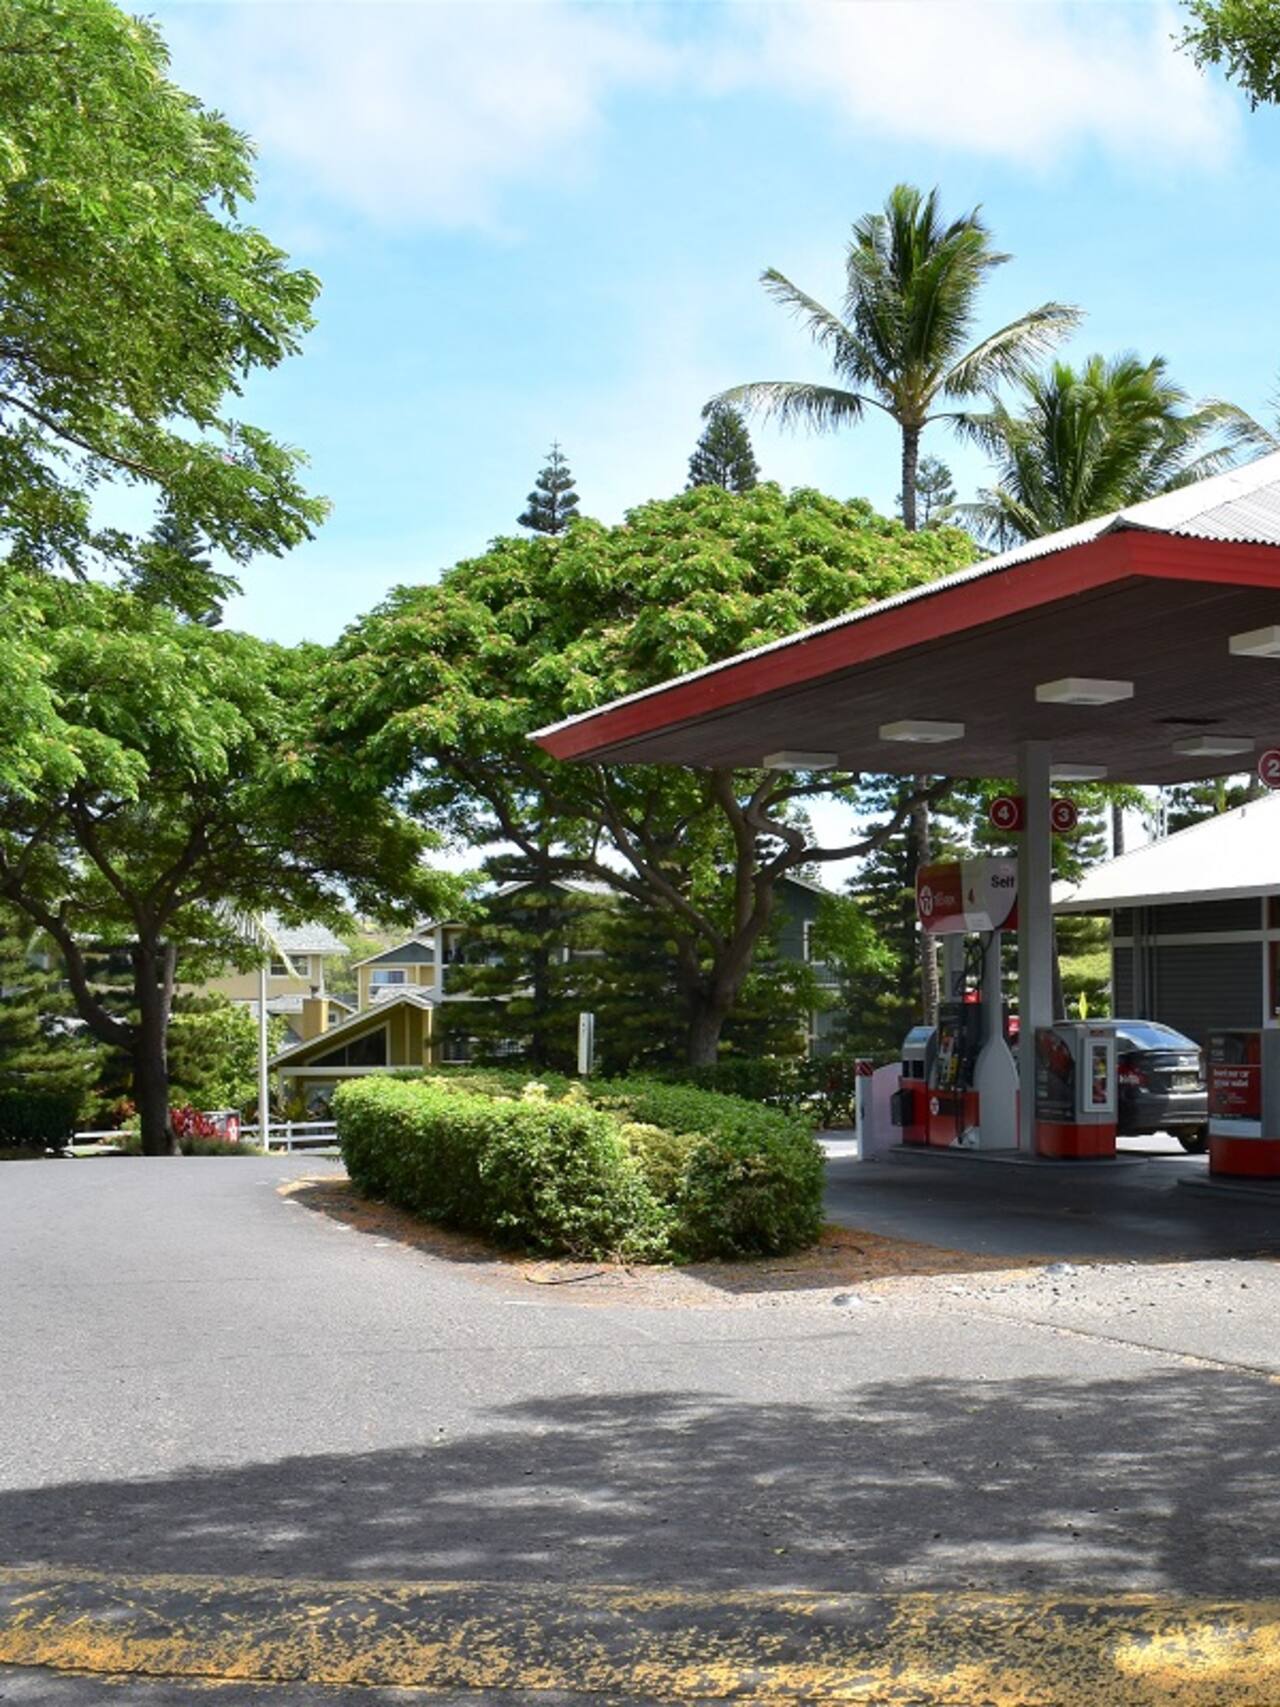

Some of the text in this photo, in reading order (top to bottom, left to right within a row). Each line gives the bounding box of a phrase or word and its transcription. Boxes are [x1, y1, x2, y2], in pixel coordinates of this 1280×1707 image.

[1267, 759, 1280, 777] 2
[998, 805, 1009, 820] 4
[1059, 807, 1069, 822] 3
[991, 874, 1015, 888] Self
[968, 887, 975, 904] 4
